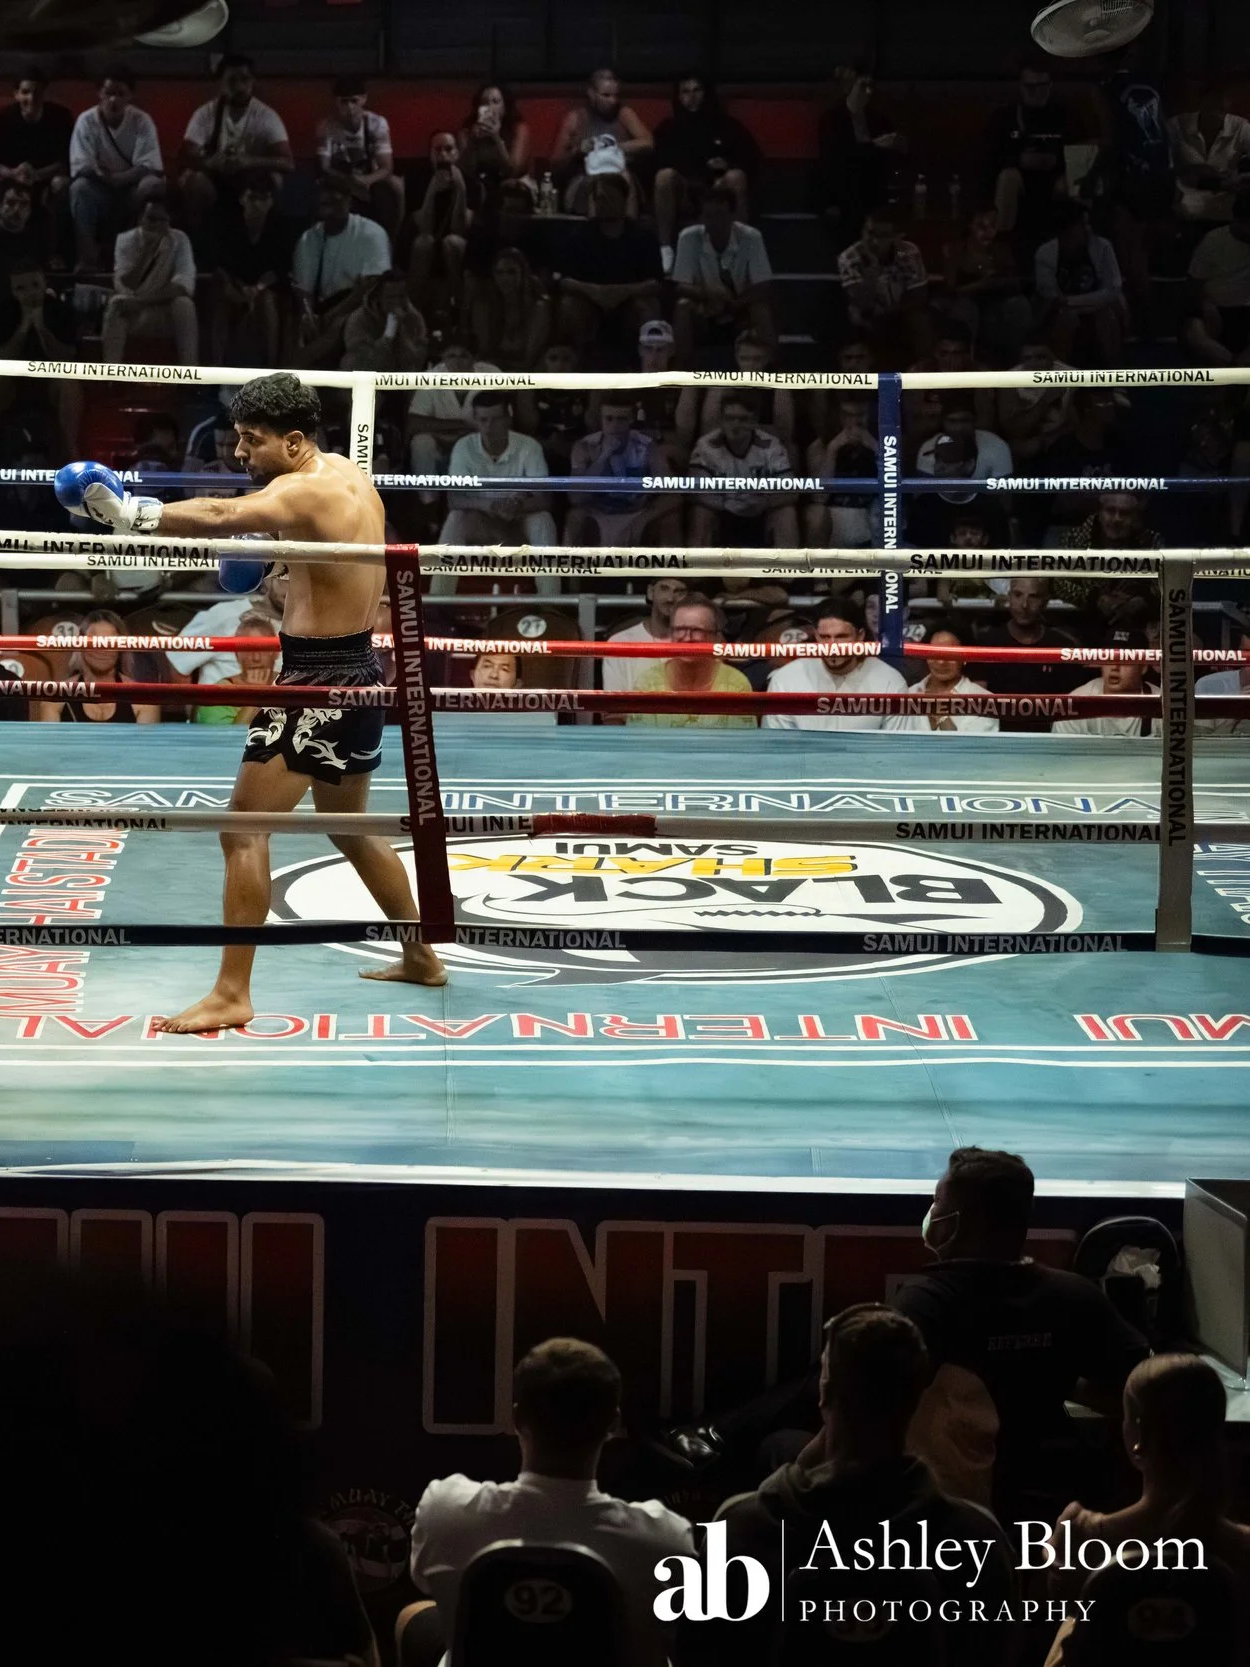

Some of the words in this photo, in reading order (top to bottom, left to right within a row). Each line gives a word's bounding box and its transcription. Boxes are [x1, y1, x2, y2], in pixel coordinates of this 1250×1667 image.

[28, 361, 78, 375] SAMUI
[82, 364, 202, 381] INTERNATIONAL
[375, 375, 410, 386] MUI
[415, 375, 535, 386] INTERNATIONAL
[750, 372, 872, 385] INTERNATIONAL
[1032, 371, 1084, 384] SAMUI
[1089, 370, 1215, 383] INTERNATIONAL
[356, 424, 369, 475] SAMU
[884, 435, 898, 488] SAMUI
[20, 469, 143, 483] INTENAL
[373, 474, 482, 487] NTERNATIONAL
[642, 477, 695, 489] SAMUI
[700, 477, 824, 490] INTERNATIONAL
[986, 478, 1039, 490] SAMUI
[1044, 478, 1168, 491] INTERNATIONAL
[87, 555, 136, 567] SAMUI
[142, 556, 219, 569] INTERNATI
[884, 493, 900, 613] INTERNONAL
[910, 554, 983, 570] SAMUI
[990, 556, 1161, 573] INTERNATIONAL
[396, 570, 419, 643] SAMUI
[1168, 588, 1186, 664] SAMUI
[36, 635, 88, 648] SAMUI
[92, 636, 215, 650] INTERNATIONAL
[429, 638, 552, 653] INTERNATIONAL
[713, 643, 765, 657] SAMUI
[770, 643, 881, 657] INTERNATION
[1060, 648, 1114, 661] SAMUI
[1119, 648, 1247, 662] INTERTIONAL
[328, 688, 399, 707] SAMU
[433, 692, 585, 711] TERNATIONAL
[816, 697, 891, 714] SAMUI
[899, 698, 1079, 716] INTERNATIONAL
[403, 650, 437, 826] INTERNATIONAL
[1168, 671, 1187, 847] INTERNATIONAL
[45, 790, 232, 809] SAM
[441, 792, 1162, 815] INTERNATIONA
[896, 822, 973, 840] SAMUI
[982, 824, 1161, 842] INTERNATIONAL
[555, 842, 758, 856] SAMUI
[507, 874, 1003, 904] BLACK
[365, 925, 422, 942] SAM
[456, 927, 627, 949] NTERNATIONAL
[863, 934, 939, 952] SAMUI
[946, 935, 1129, 954] INTERNATIONAL
[1073, 1013, 1250, 1041] MUI
[513, 1586, 565, 1616] 92
